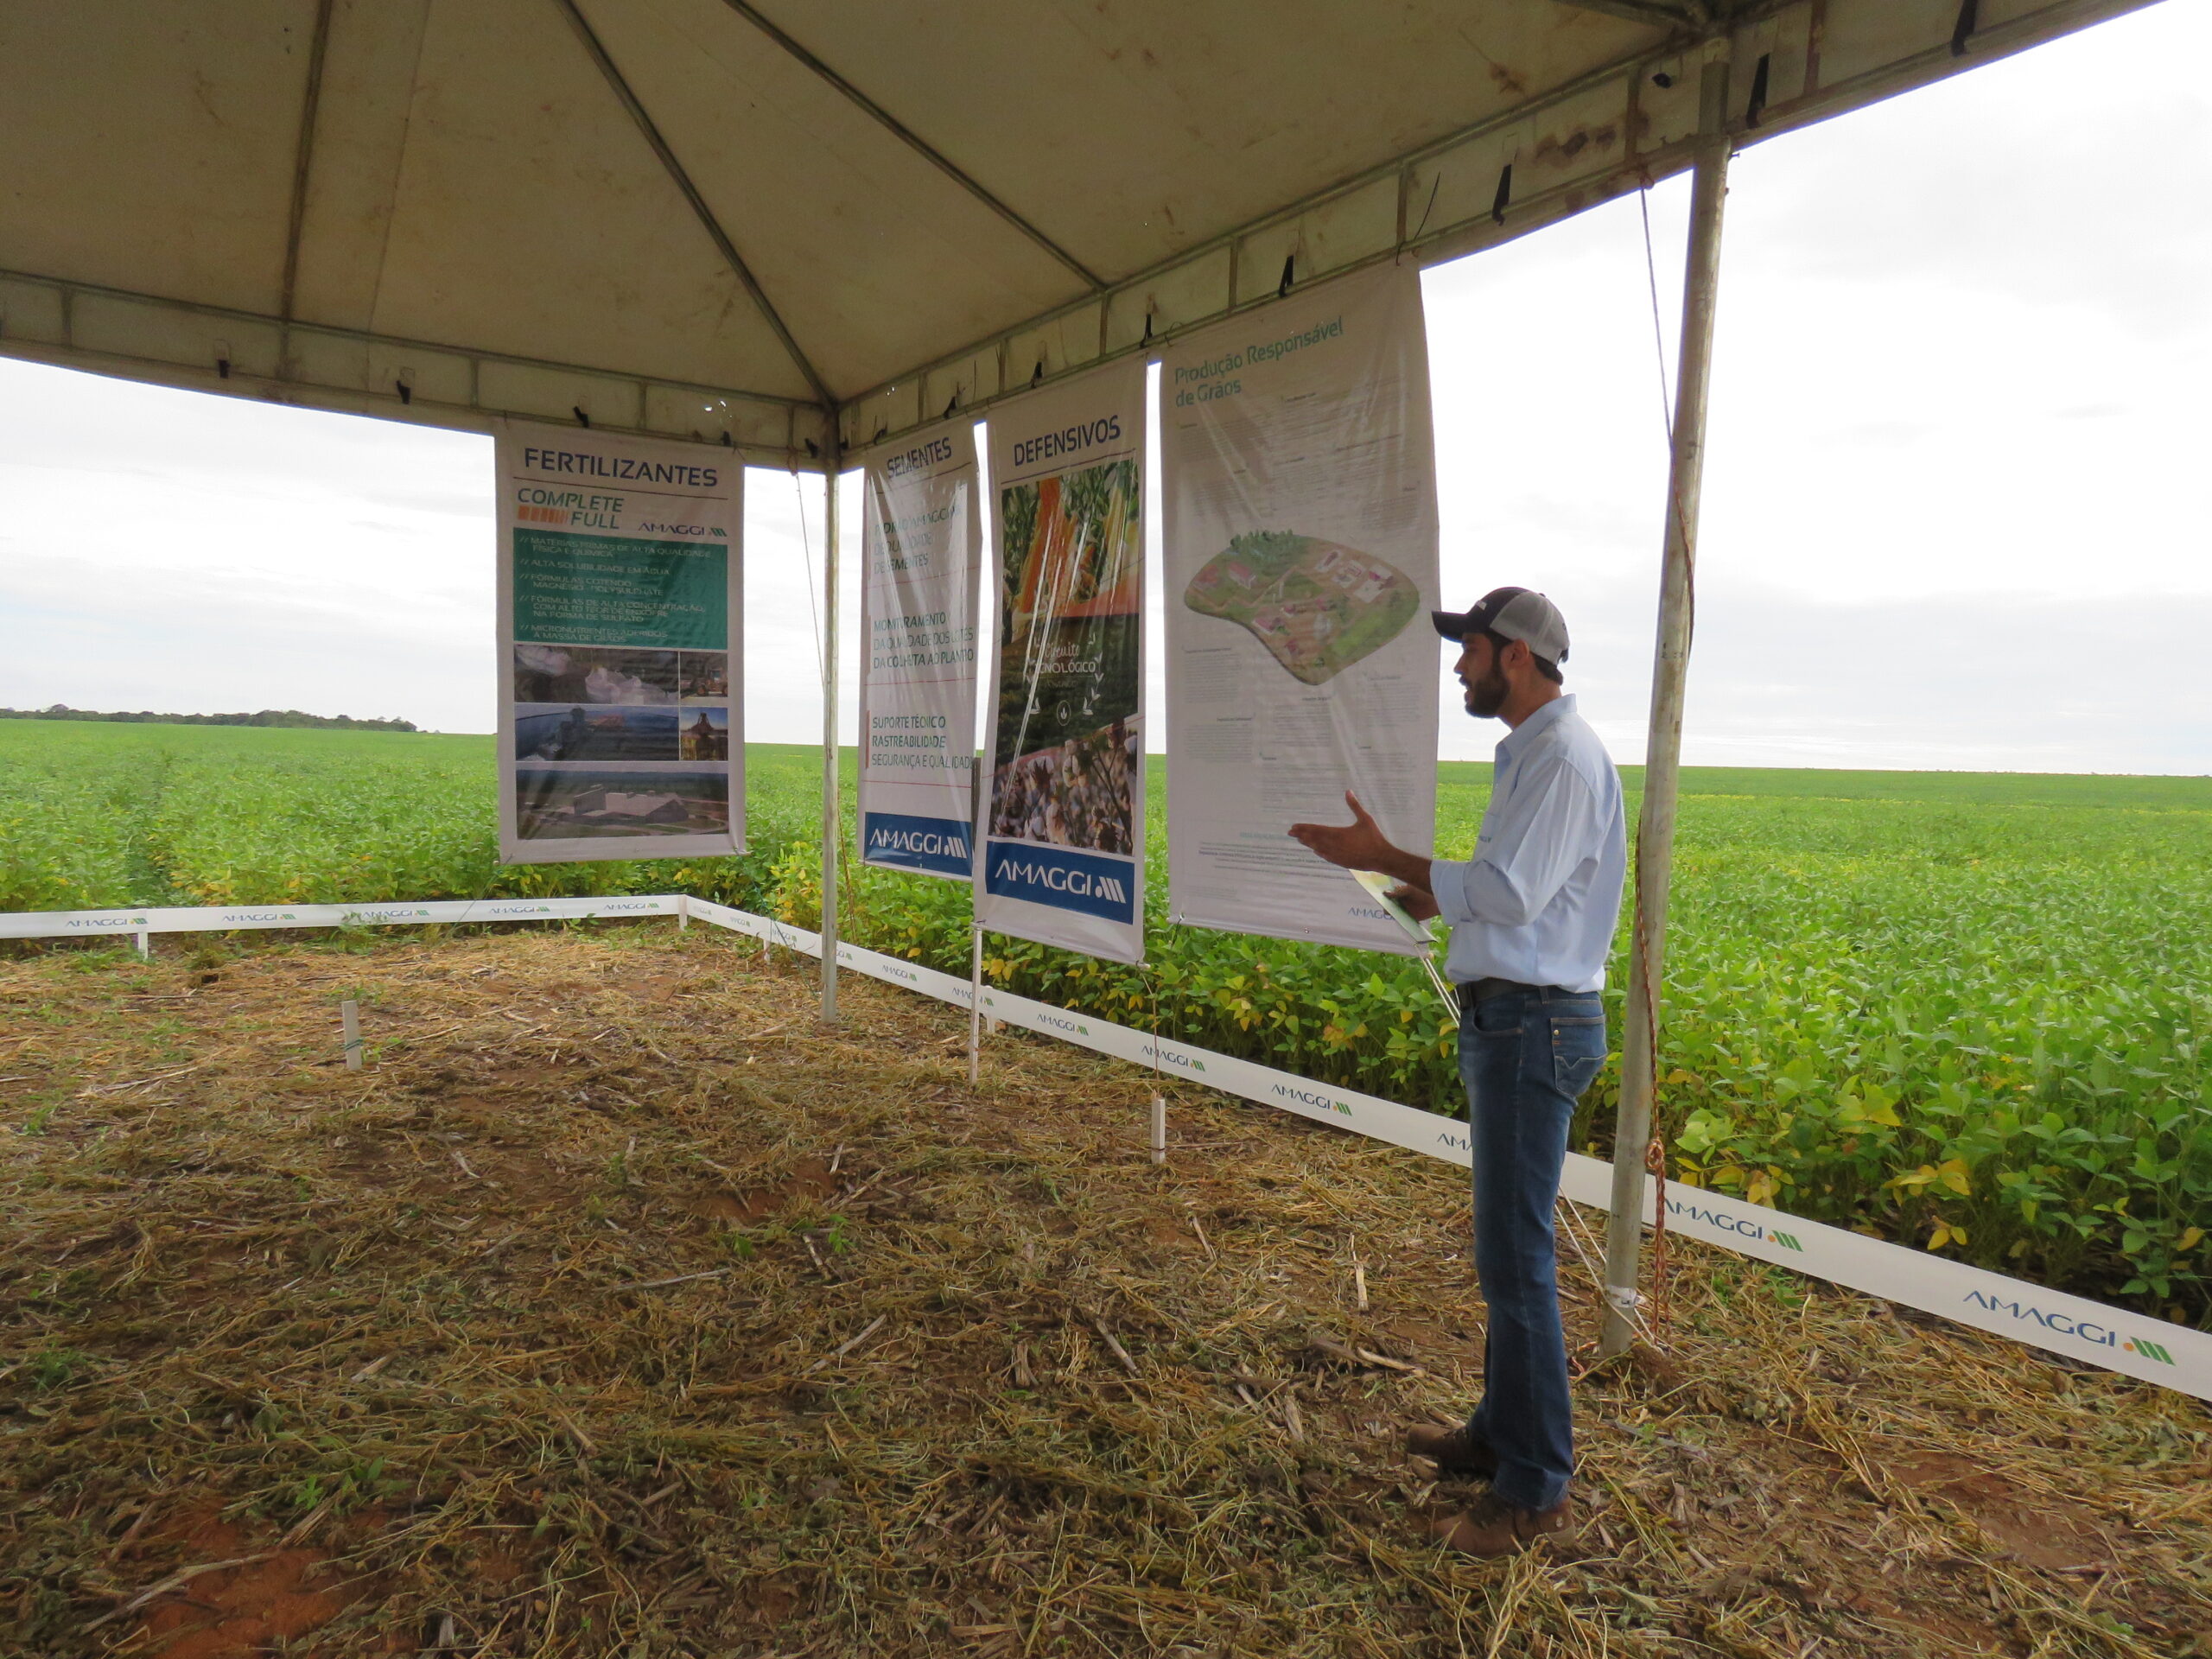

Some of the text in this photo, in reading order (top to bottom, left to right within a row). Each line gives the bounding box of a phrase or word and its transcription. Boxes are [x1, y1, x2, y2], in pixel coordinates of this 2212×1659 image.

[1175, 315, 1344, 385] Produção Responsável
[1175, 380, 1243, 408] de Grãos
[1014, 415, 1122, 467] DEFENSIVOS
[887, 437, 952, 479] SEMENTES
[524, 448, 718, 486] FERTILIZANTES
[518, 488, 624, 512] COMPLETE
[570, 512, 620, 529] FULL
[639, 522, 705, 536] AMAGGI
[658, 548, 711, 559] QUALIDADE
[887, 553, 928, 571] EMENTES
[551, 611, 584, 620] FORMA
[558, 604, 583, 613] ALTO
[531, 624, 617, 636] MICRONUTRIENTES
[543, 632, 577, 641] MASSA
[934, 632, 950, 645] DOS
[874, 657, 887, 669] DA
[928, 652, 940, 664] AO
[872, 714, 946, 728] SUPORTE TÉCNICO
[872, 735, 947, 748] RASTREABILIDADE
[871, 753, 921, 770] SEGURANÇA
[923, 754, 927, 767] E
[869, 828, 942, 855] AMAGGI
[995, 859, 1091, 897] AMAGGI
[65, 917, 128, 927] AMAGGI
[221, 913, 277, 922] AMAGGI
[881, 963, 909, 980] AMAGGI
[1037, 1013, 1076, 1032] AMAGGI
[1141, 1045, 1189, 1067] AMAGGI
[1271, 1084, 1331, 1109] AMAGGI
[1962, 1290, 2116, 1348] AMAGGI
